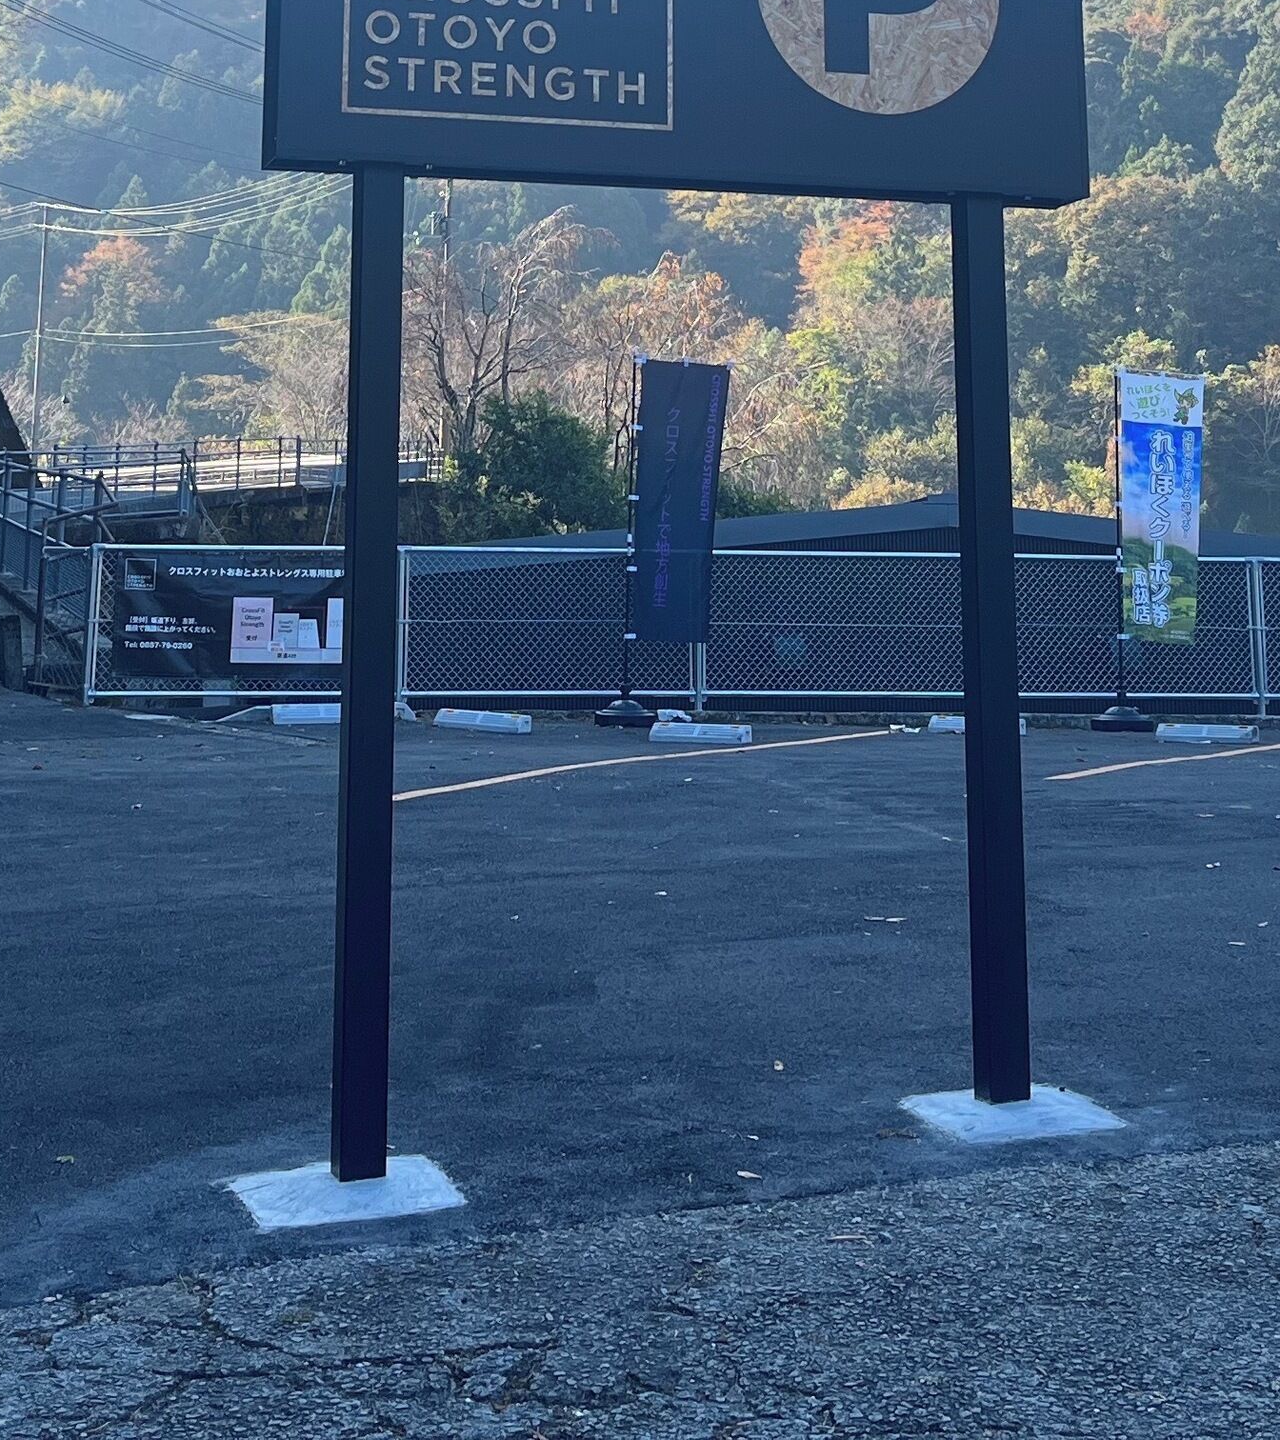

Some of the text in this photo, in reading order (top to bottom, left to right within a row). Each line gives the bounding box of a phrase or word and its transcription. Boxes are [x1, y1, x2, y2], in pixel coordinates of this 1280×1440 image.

[364, 9, 558, 55] OTOYO
[362, 55, 647, 107] STRENGTH
[704, 426, 717, 464] OTOYO
[699, 465, 713, 522] STRENGTH
[1149, 429, 1176, 627] れいほくクーポン券
